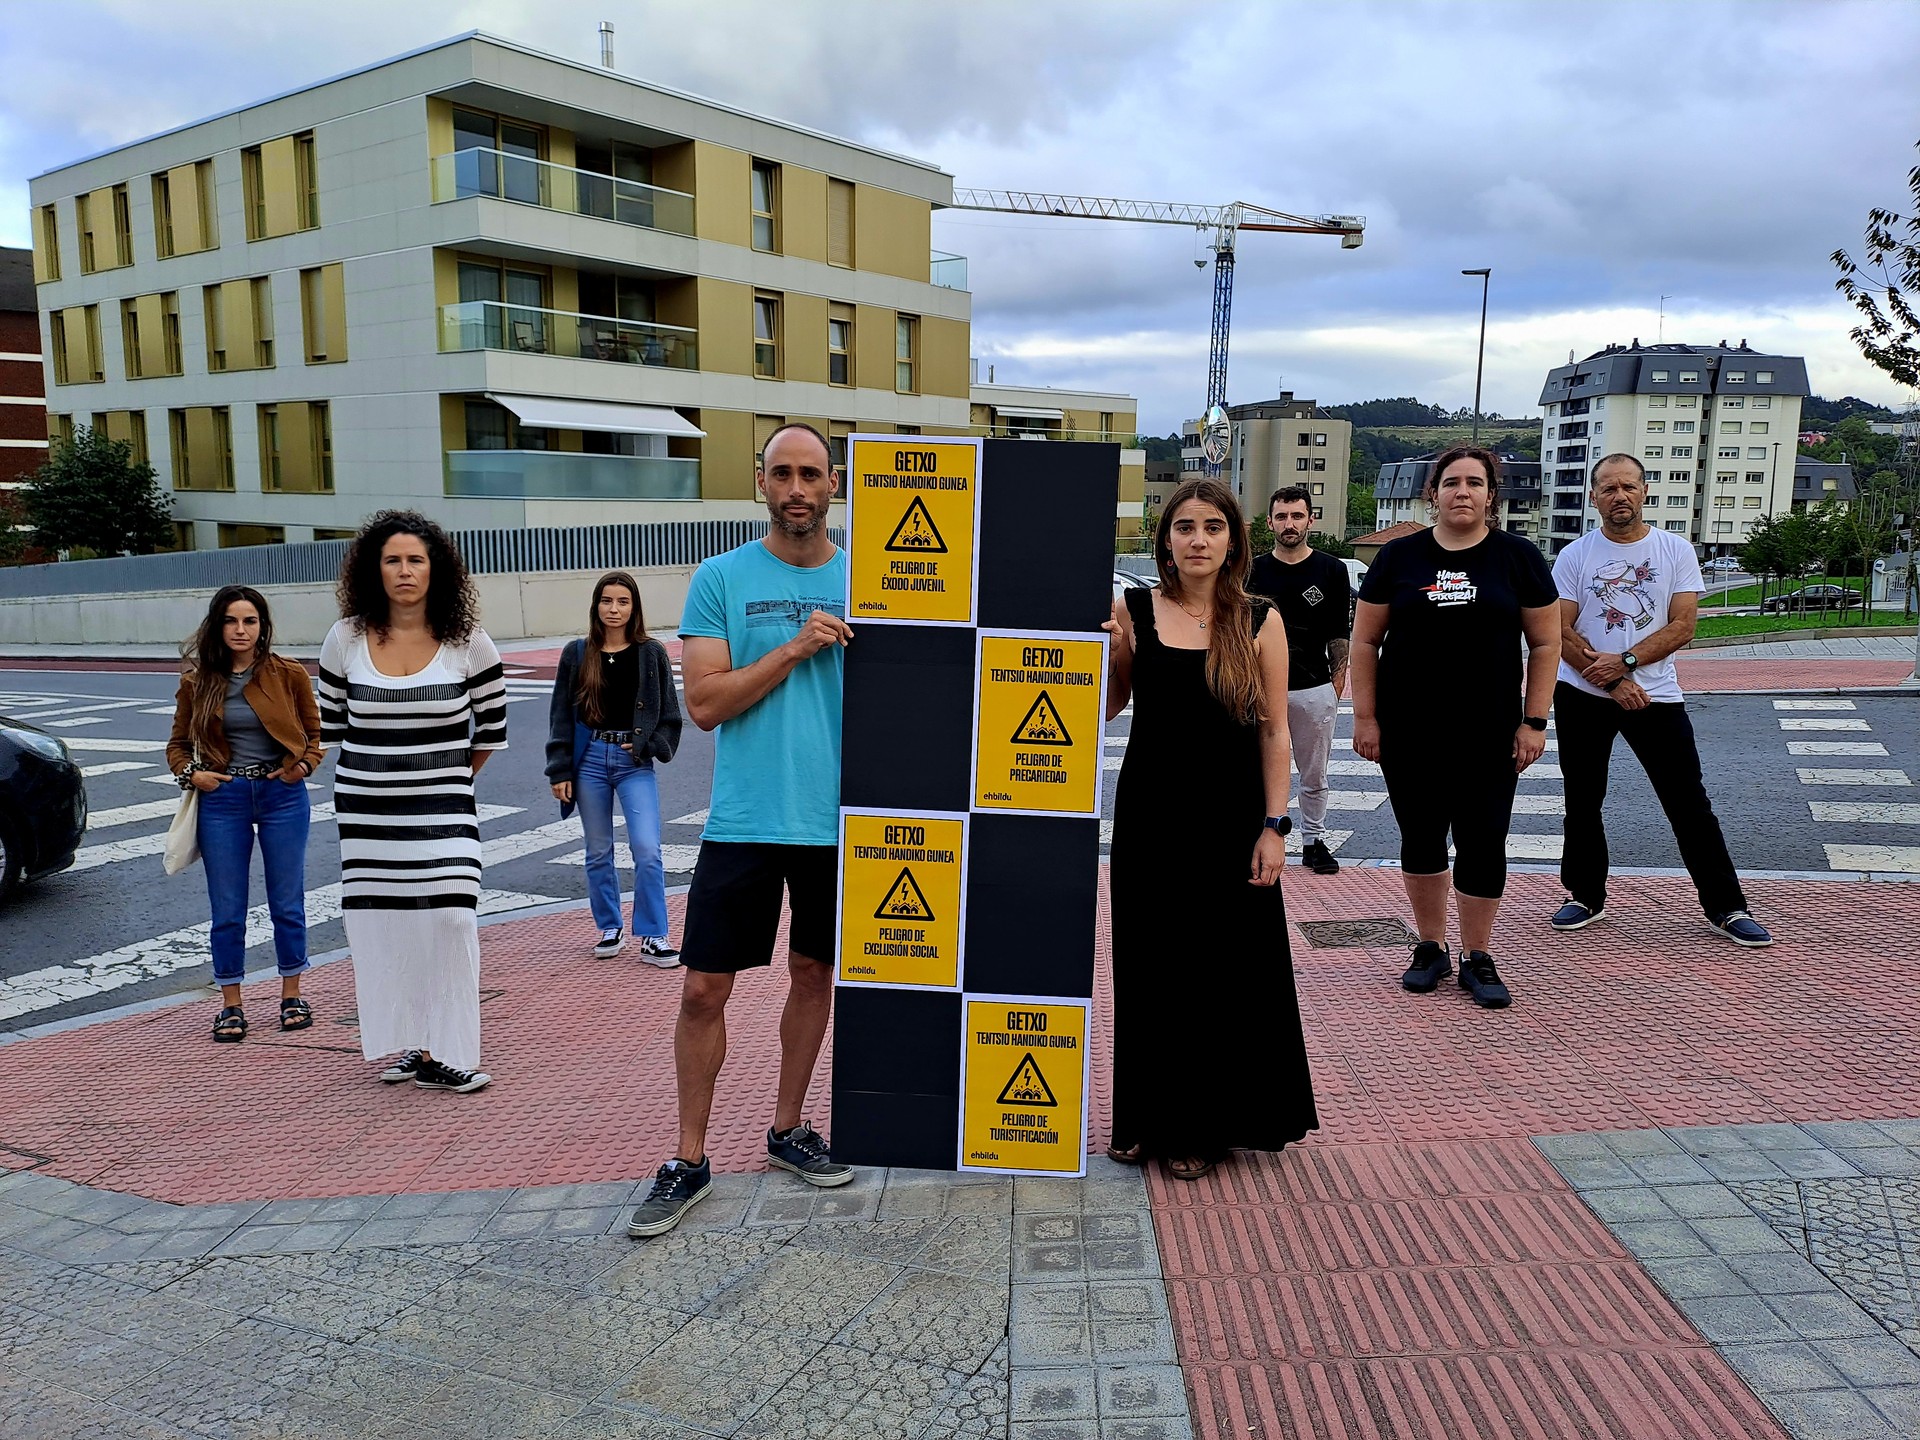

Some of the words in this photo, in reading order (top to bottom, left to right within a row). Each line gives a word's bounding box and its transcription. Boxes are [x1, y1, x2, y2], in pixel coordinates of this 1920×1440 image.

[895, 451, 936, 472] GETXO
[863, 474, 897, 488] TENTSIO
[900, 475, 937, 489] HANDIKO
[939, 477, 967, 490] GUNEA
[891, 561, 924, 575] PELIGRO
[927, 563, 937, 575] DE
[882, 574, 908, 590] ÉXODO
[911, 579, 945, 592] JUVENIL
[859, 602, 887, 610] ehbildu
[1022, 647, 1063, 668] GETXO
[991, 669, 1024, 682] TENTSIO
[1027, 671, 1063, 684] HANDIKO
[1066, 672, 1093, 686] GUNEA
[1016, 753, 1050, 766] PELIGRO
[1052, 755, 1062, 767] DE
[1010, 769, 1067, 783] PRECARIEDAD
[984, 792, 1012, 800] ehbildu
[885, 825, 924, 845] GETXO
[853, 846, 886, 859] TENTSIO
[889, 848, 925, 861] HANDIKO
[927, 850, 954, 863] GUNEA
[879, 928, 912, 941] PELIGRO
[915, 930, 925, 942] DE
[864, 942, 908, 957] EXCLUSIÓN
[910, 945, 939, 958] SOCIAL
[848, 966, 875, 974] ehbildu
[1007, 1011, 1046, 1031] GETXO
[976, 1032, 1009, 1045] TENTSIO
[1012, 1034, 1048, 1047] HANDIKO
[1050, 1036, 1076, 1048] GUNEA
[1002, 1113, 1035, 1127] PELIGRO
[1037, 1115, 1048, 1127] DE
[990, 1128, 1058, 1144] TURISTIFICACIÓN
[971, 1151, 998, 1160] ehbildu
